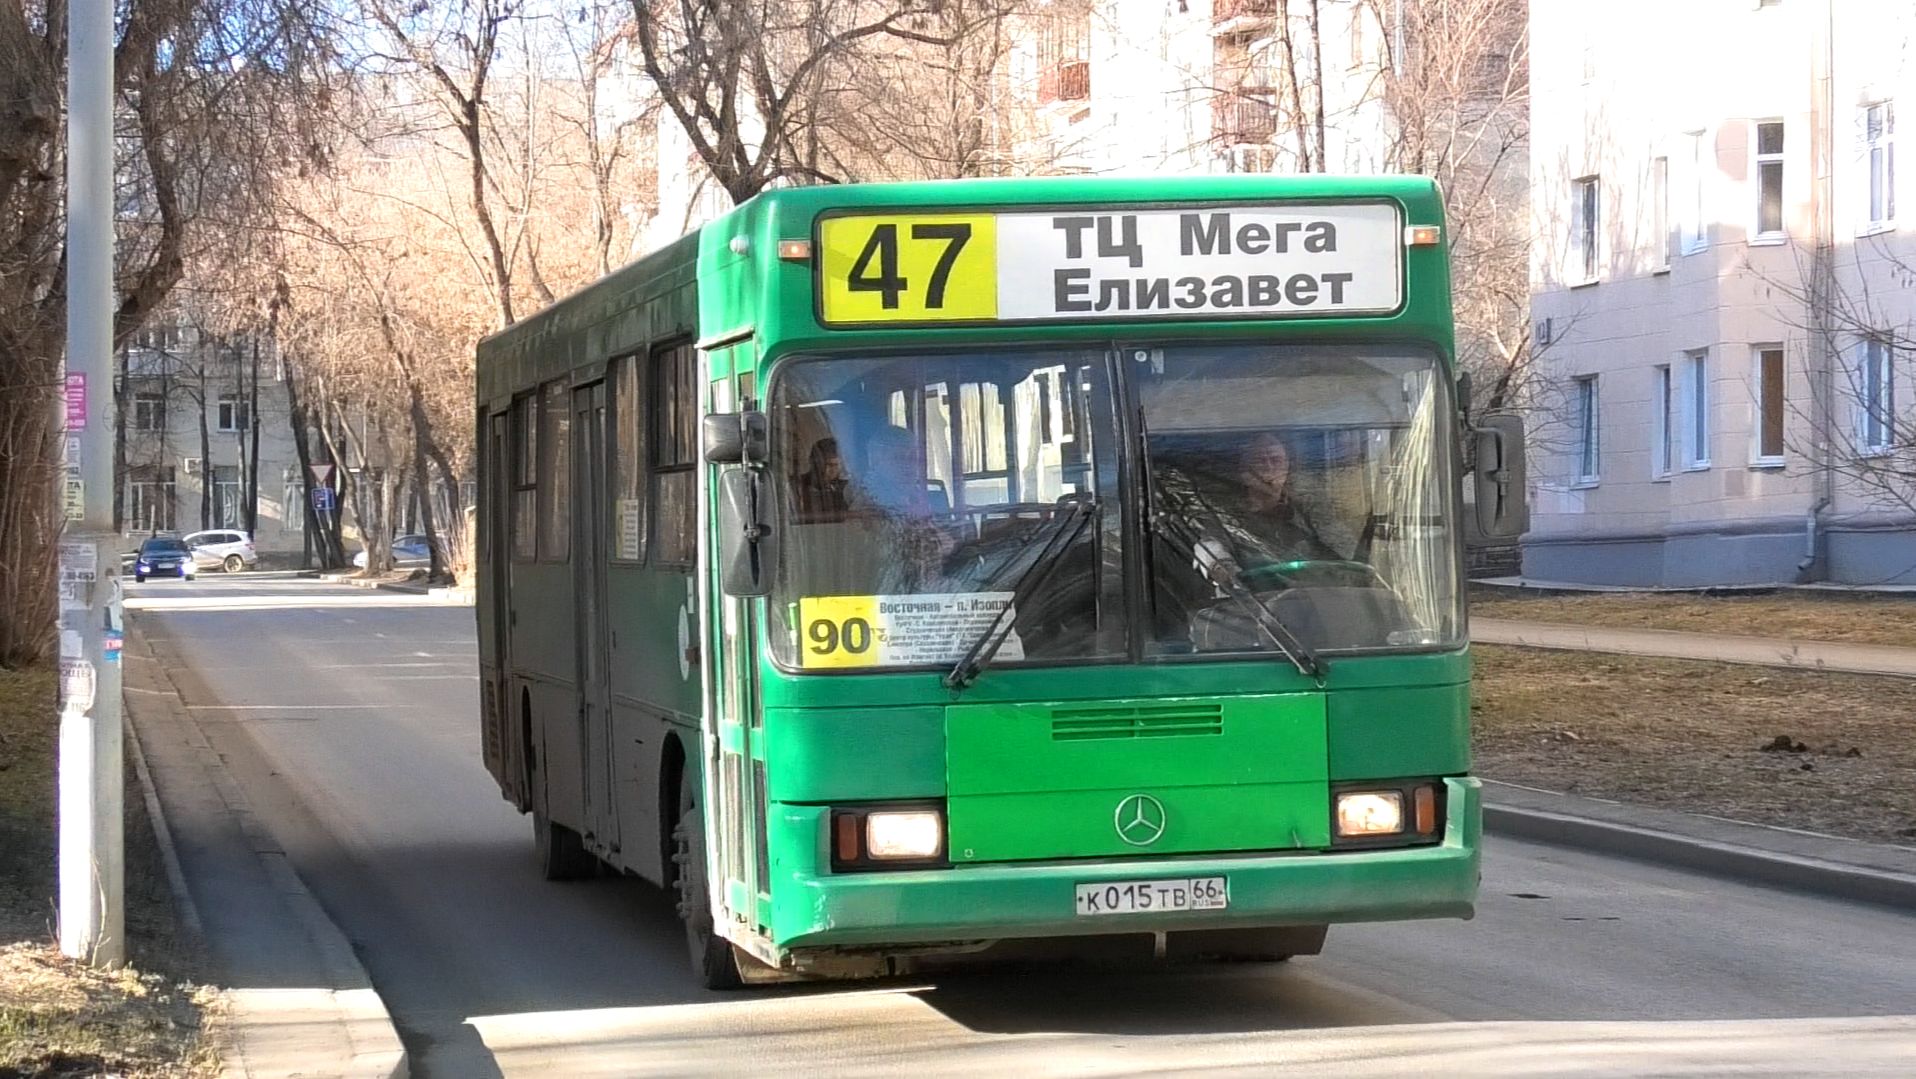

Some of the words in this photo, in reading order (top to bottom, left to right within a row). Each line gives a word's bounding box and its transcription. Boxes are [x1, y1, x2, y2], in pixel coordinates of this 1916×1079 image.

[1053, 214, 1143, 266] ТЦ
[1180, 213, 1337, 255] Мега
[847, 222, 973, 310] 47
[1053, 268, 1353, 314] Елизавет
[880, 602, 941, 614] Восточная
[808, 617, 871, 655] 90
[1087, 884, 1185, 911] К015ТВ
[1193, 880, 1217, 899] 66
